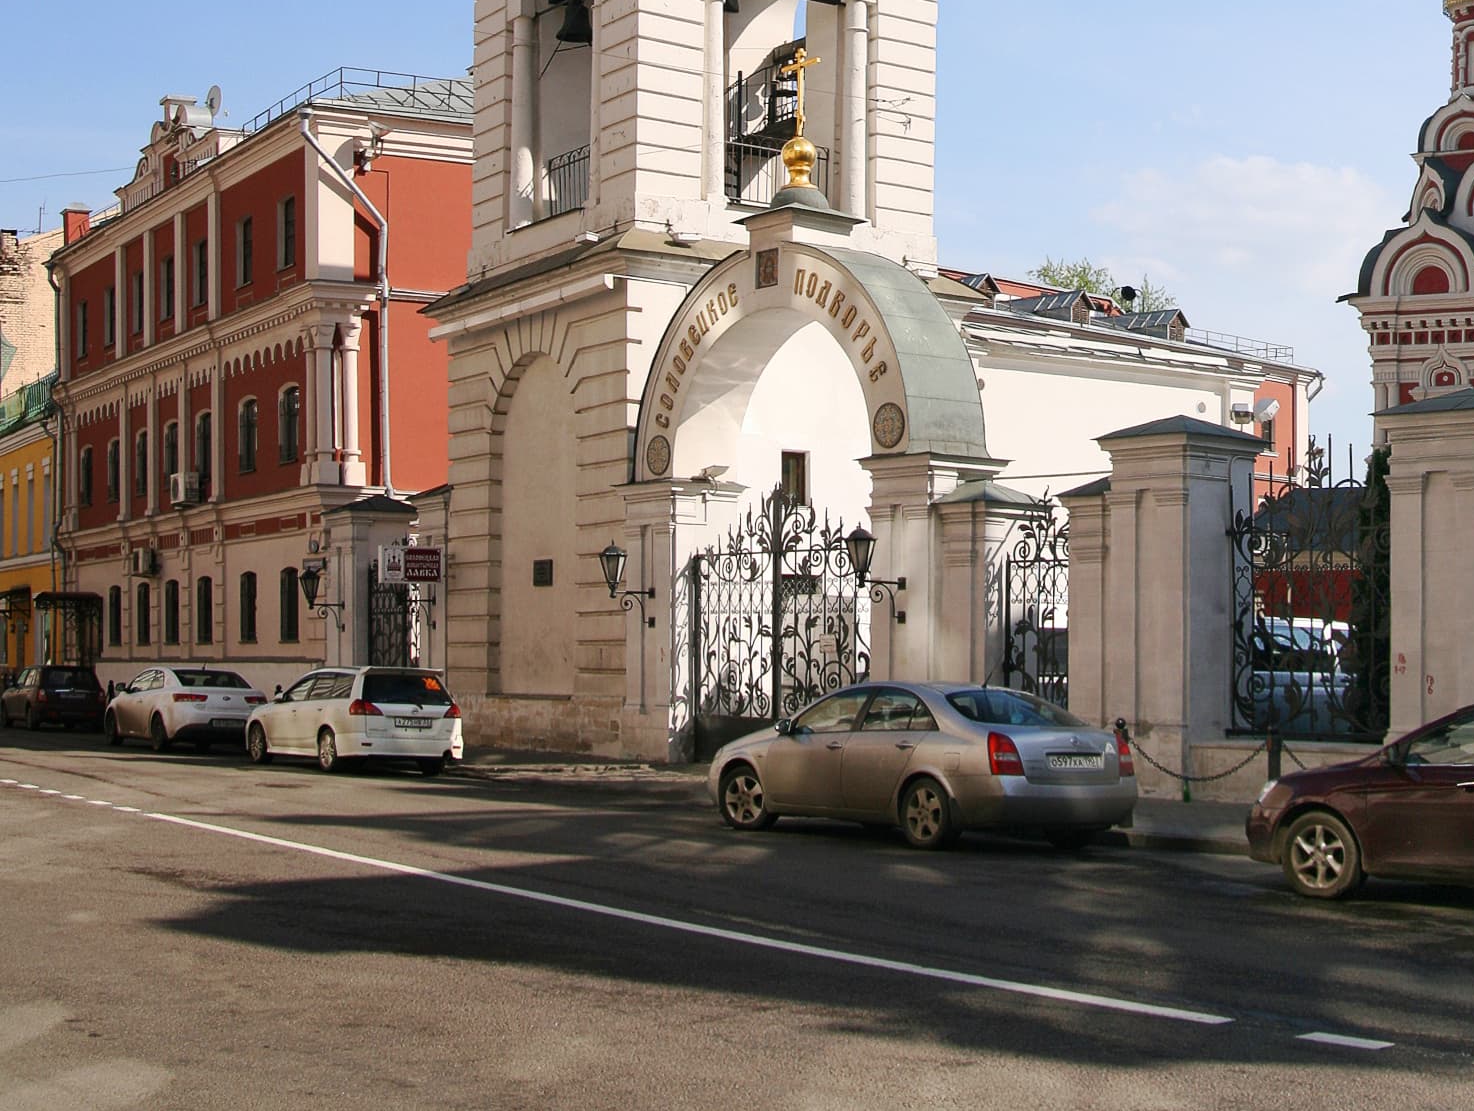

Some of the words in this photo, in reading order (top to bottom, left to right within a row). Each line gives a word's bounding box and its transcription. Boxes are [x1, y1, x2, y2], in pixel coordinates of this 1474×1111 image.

[655, 282, 739, 429] СОЛОВЕЦКОЕ
[794, 269, 888, 383] ПОДВОРЬЕ
[406, 568, 438, 577] ЛАВКА
